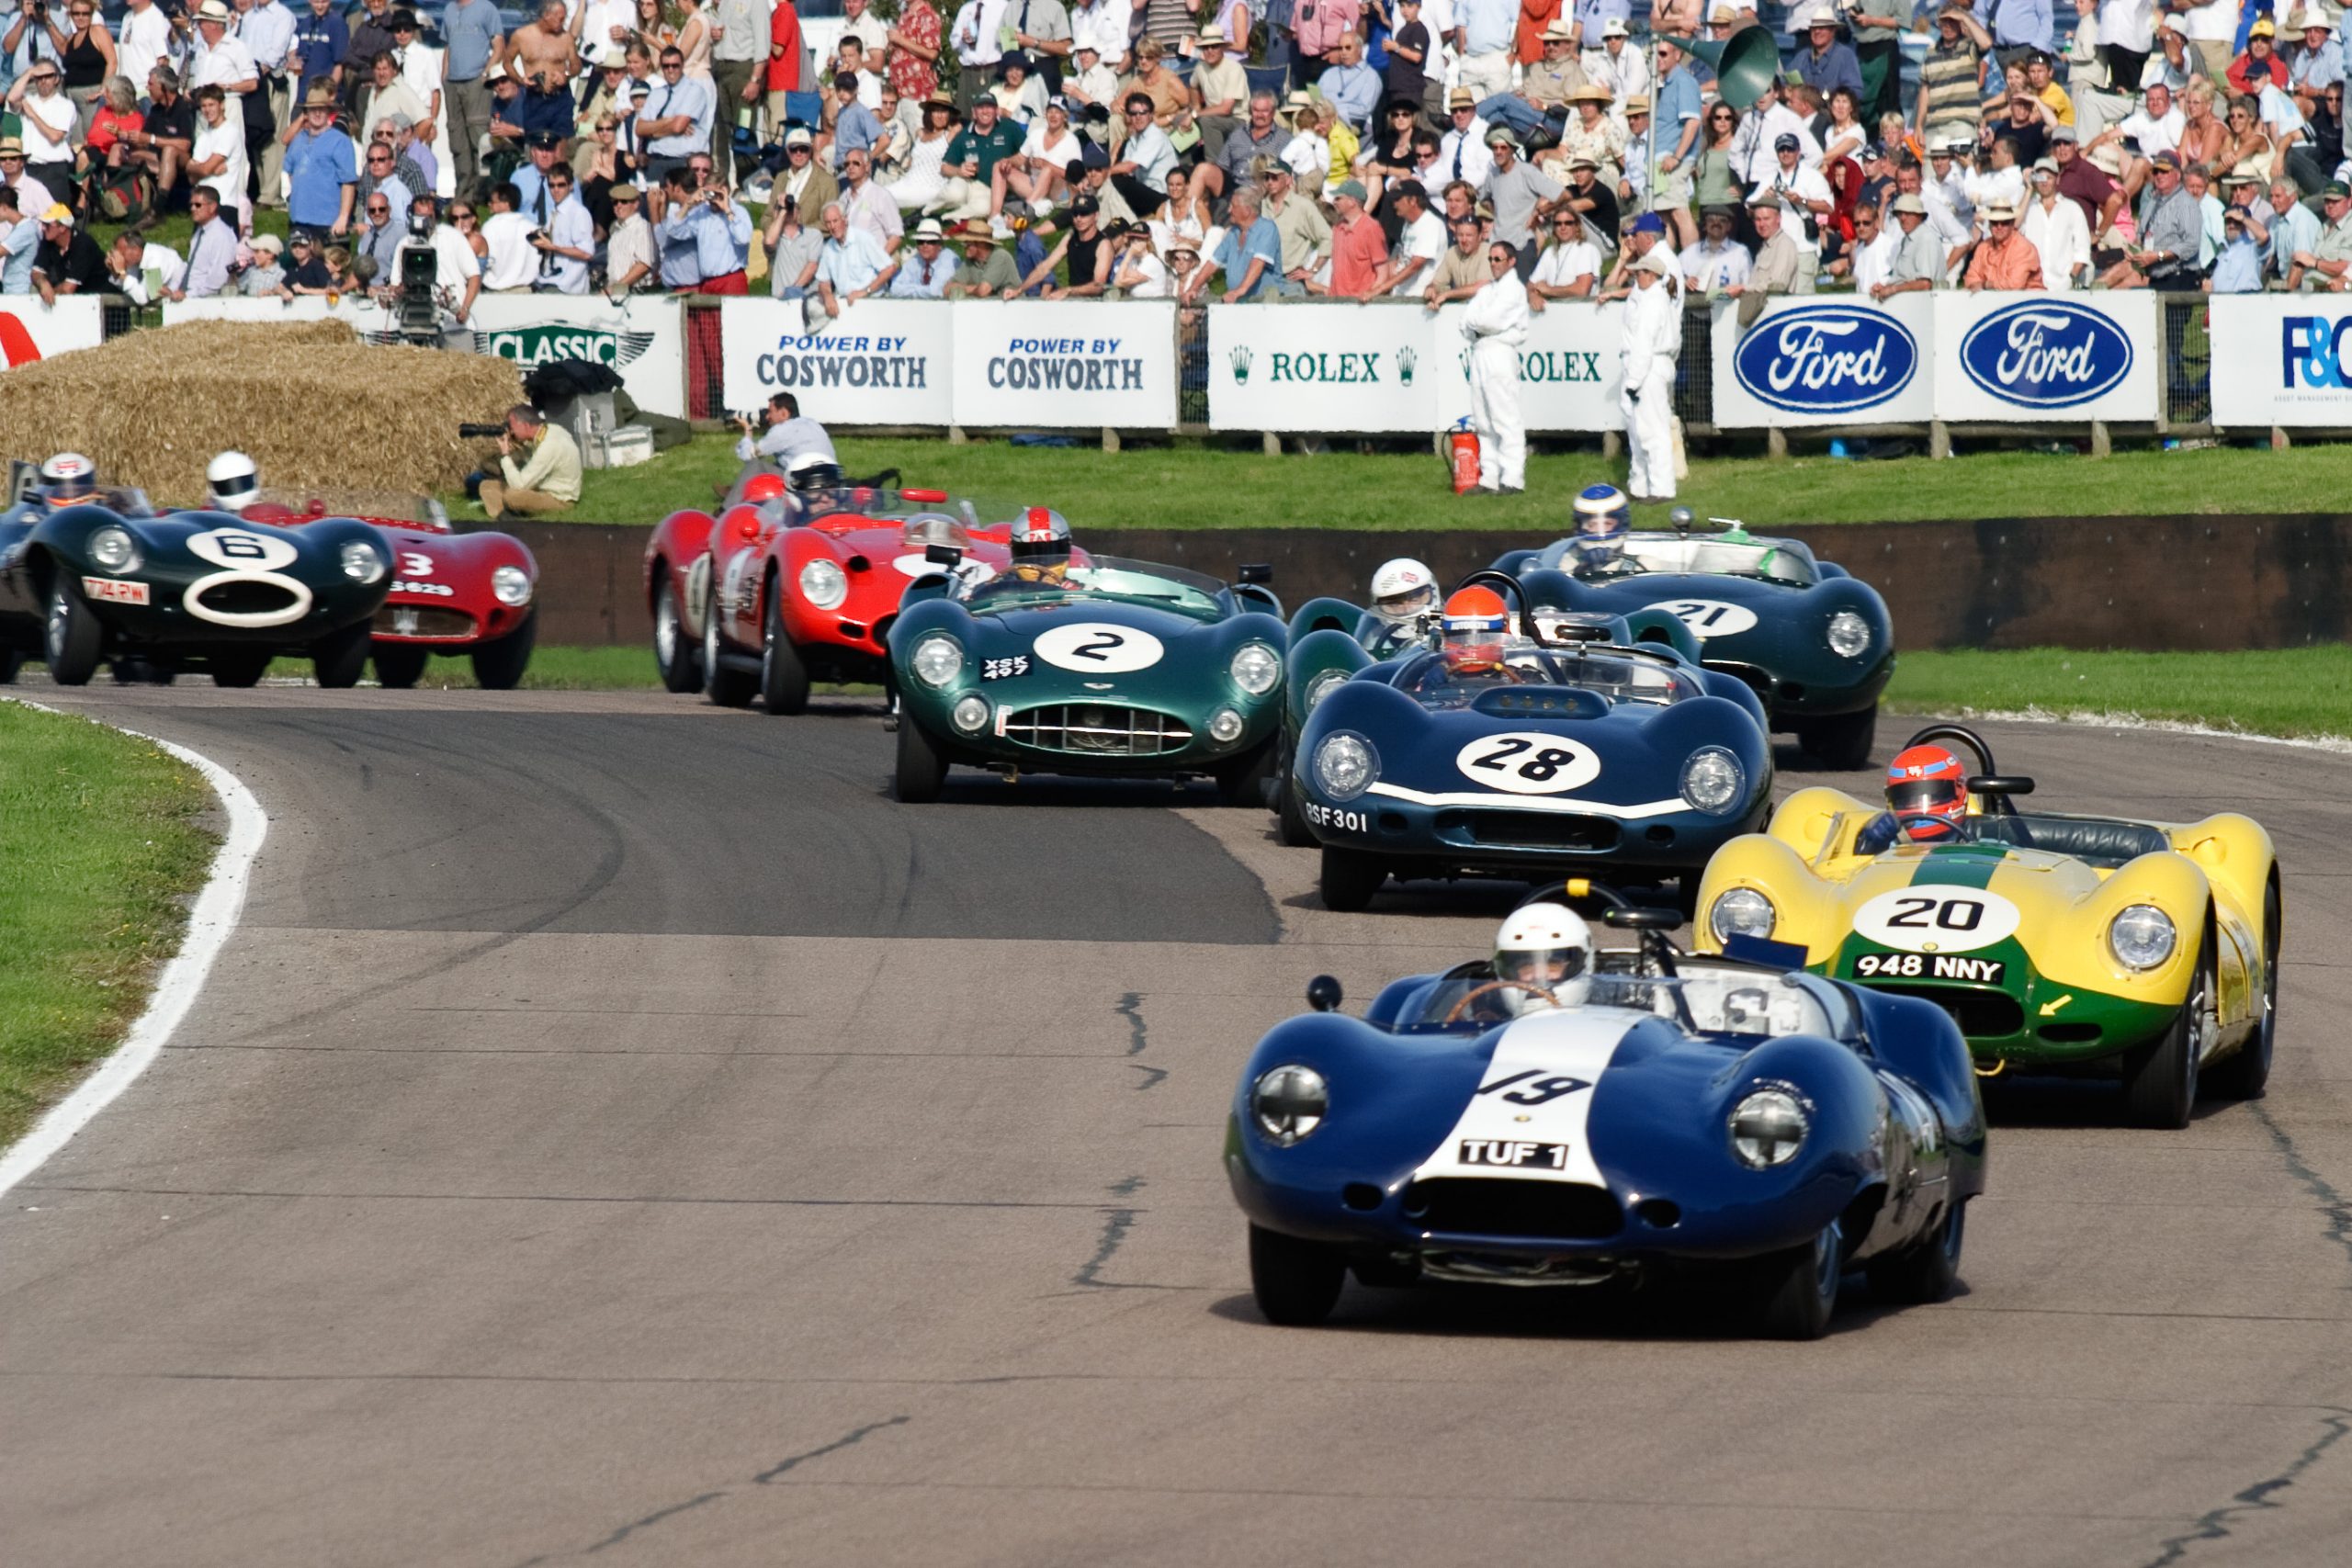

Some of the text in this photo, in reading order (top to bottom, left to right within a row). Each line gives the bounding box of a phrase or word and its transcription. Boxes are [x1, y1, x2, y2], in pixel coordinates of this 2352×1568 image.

[491, 333, 616, 367] CLASSIC
[778, 335, 908, 352] POWER BY
[1009, 338, 1122, 355] POWER BY
[1768, 321, 1888, 390] Ford
[1996, 314, 2097, 384] Ford
[756, 354, 927, 389] COSWORTH
[988, 356, 1144, 390] COSWORTH
[1270, 353, 1380, 383] ROLEX
[217, 536, 266, 559] 6
[401, 552, 435, 576] 3
[1676, 604, 1728, 626] 21
[1071, 633, 1124, 660] 2
[983, 664, 1029, 679] 497
[984, 655, 1029, 670] XSK
[1472, 738, 1576, 781] 28
[1887, 898, 1984, 931] 20
[1858, 954, 2001, 982] 948 NNY
[1476, 1069, 1592, 1105] 19
[1464, 1141, 1566, 1168] TUF 1
